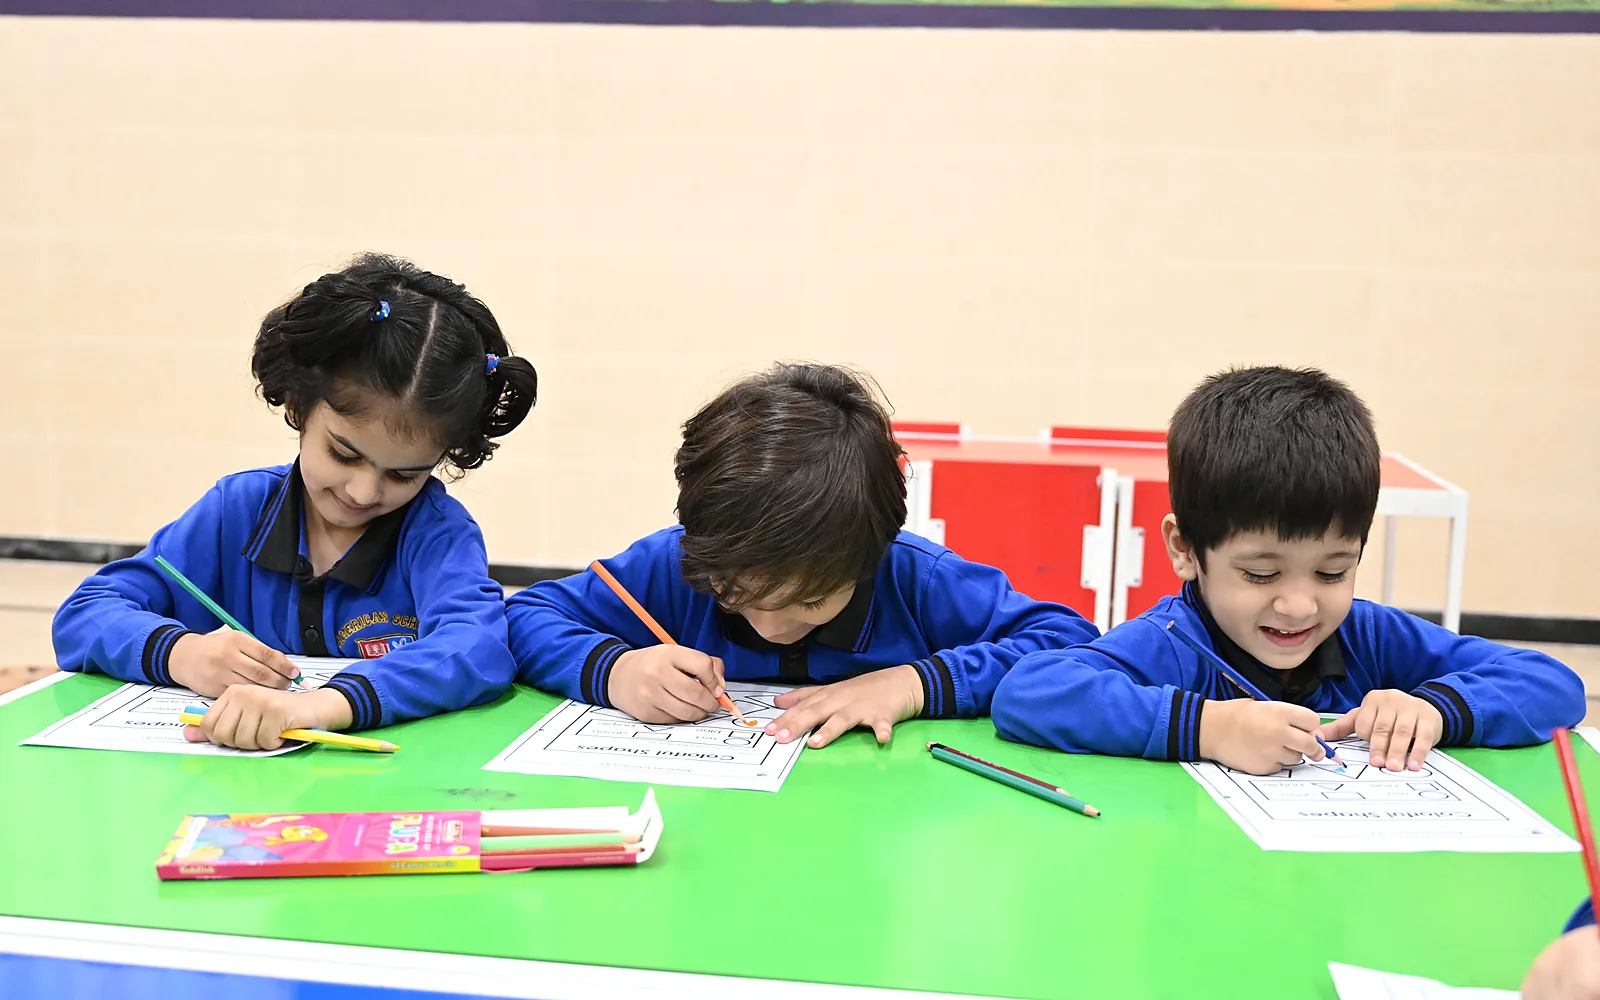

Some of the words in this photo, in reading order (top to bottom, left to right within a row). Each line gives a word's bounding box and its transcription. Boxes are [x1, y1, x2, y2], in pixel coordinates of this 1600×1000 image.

[335, 611, 389, 648] AMERICAN
[124, 719, 187, 730] hapes
[576, 744, 651, 756] Shapes
[654, 748, 735, 762] Colorful
[1298, 809, 1381, 819] Shapes
[1386, 810, 1472, 819] Colorful
[385, 813, 423, 854] FLUPA
